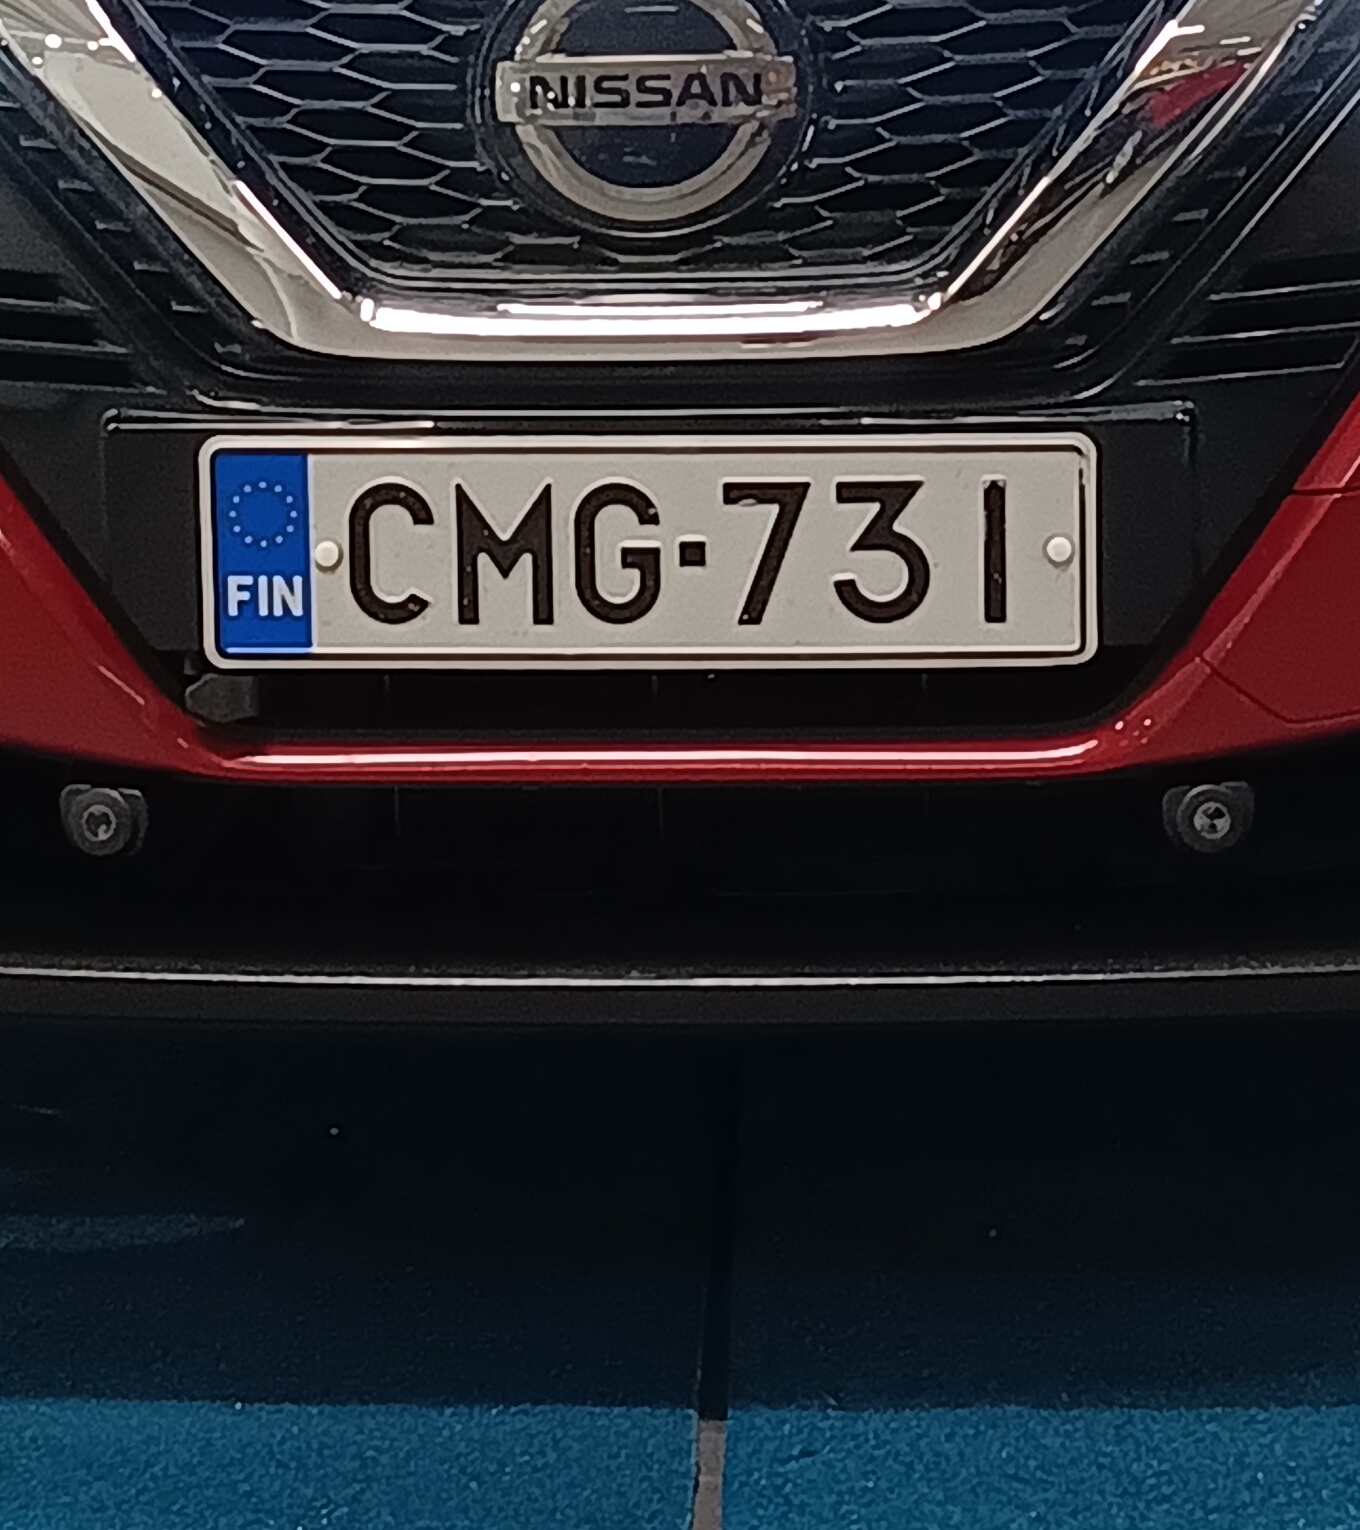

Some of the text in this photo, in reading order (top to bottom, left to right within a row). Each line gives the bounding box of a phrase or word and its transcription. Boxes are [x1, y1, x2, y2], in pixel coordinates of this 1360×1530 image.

[529, 72, 762, 109] NISSAN
[348, 480, 1007, 625] CMG-731
[227, 574, 303, 617] FIN
